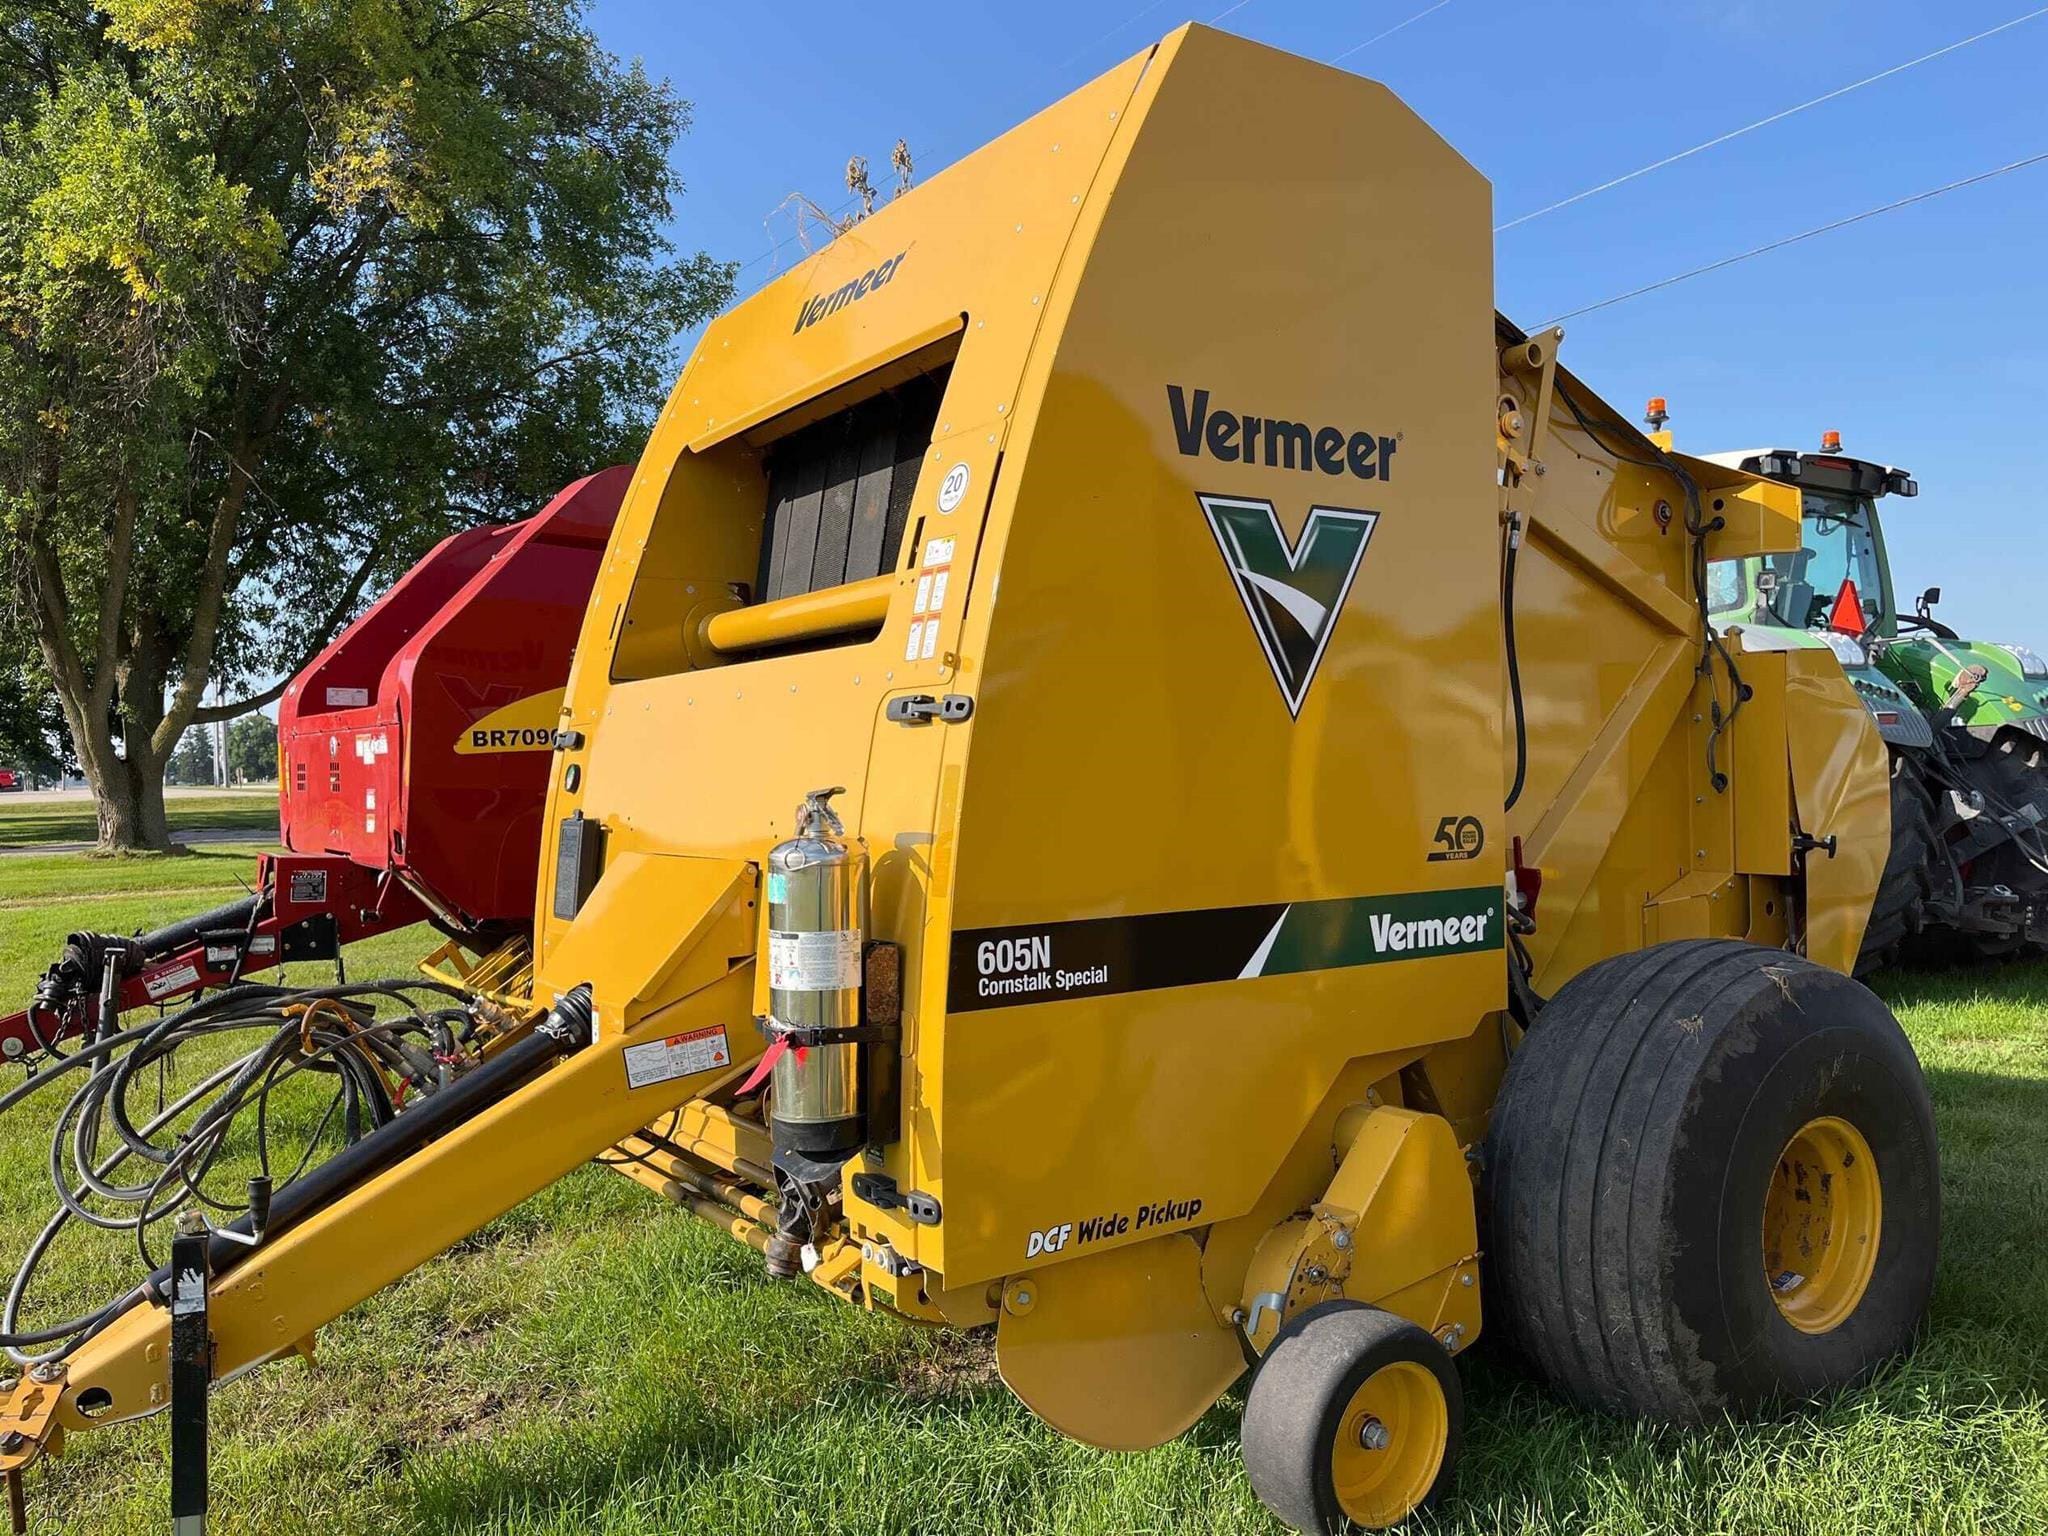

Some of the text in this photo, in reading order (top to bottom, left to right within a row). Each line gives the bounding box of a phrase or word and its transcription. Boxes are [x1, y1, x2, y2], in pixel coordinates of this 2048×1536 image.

[793, 251, 907, 336] Vermeer
[1166, 384, 1397, 482] Vermeer
[944, 472, 963, 495] 20
[1445, 852, 1469, 860] YEARS
[1369, 913, 1488, 953] Vermeer
[977, 935, 1051, 975] 605N
[979, 965, 1108, 996] Cornstalk Special
[681, 1029, 718, 1042] WARNING
[1025, 1199, 1202, 1259] DCF Wide Pickup
